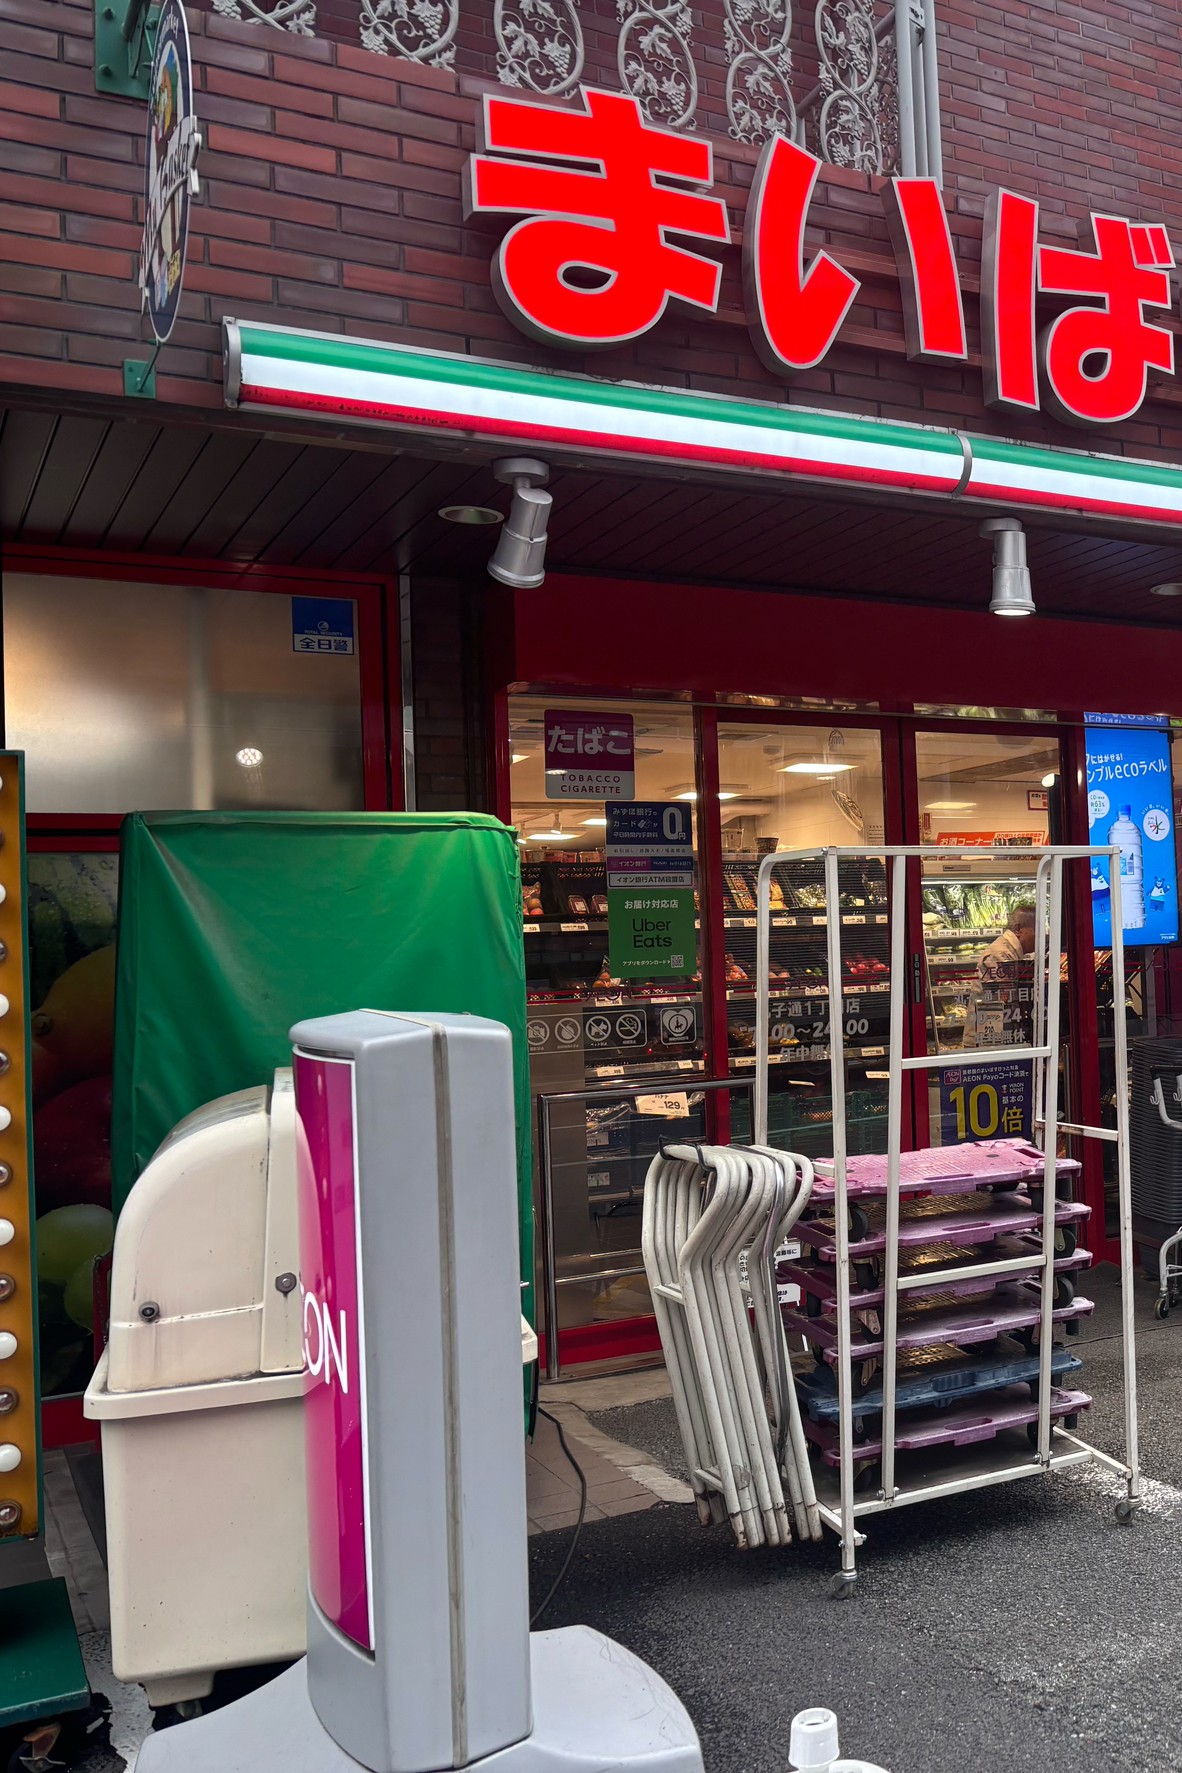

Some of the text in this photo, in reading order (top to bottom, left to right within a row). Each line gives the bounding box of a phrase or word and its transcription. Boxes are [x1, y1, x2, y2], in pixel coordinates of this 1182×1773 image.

[299, 637, 348, 652] 全日警
[548, 725, 632, 755] たばこ
[560, 774, 621, 784] TOBACCO
[560, 785, 621, 794] CIGARETTE
[624, 899, 679, 910] お届け対応店
[632, 918, 672, 932] Uber
[633, 934, 673, 949] Eats
[768, 998, 861, 1019] 子通1丁店
[962, 1075, 982, 1083] AEON
[664, 1101, 681, 1110] 129
[949, 1084, 999, 1140] 10
[1002, 1106, 1024, 1133] 倍
[301, 1284, 348, 1394] ON
